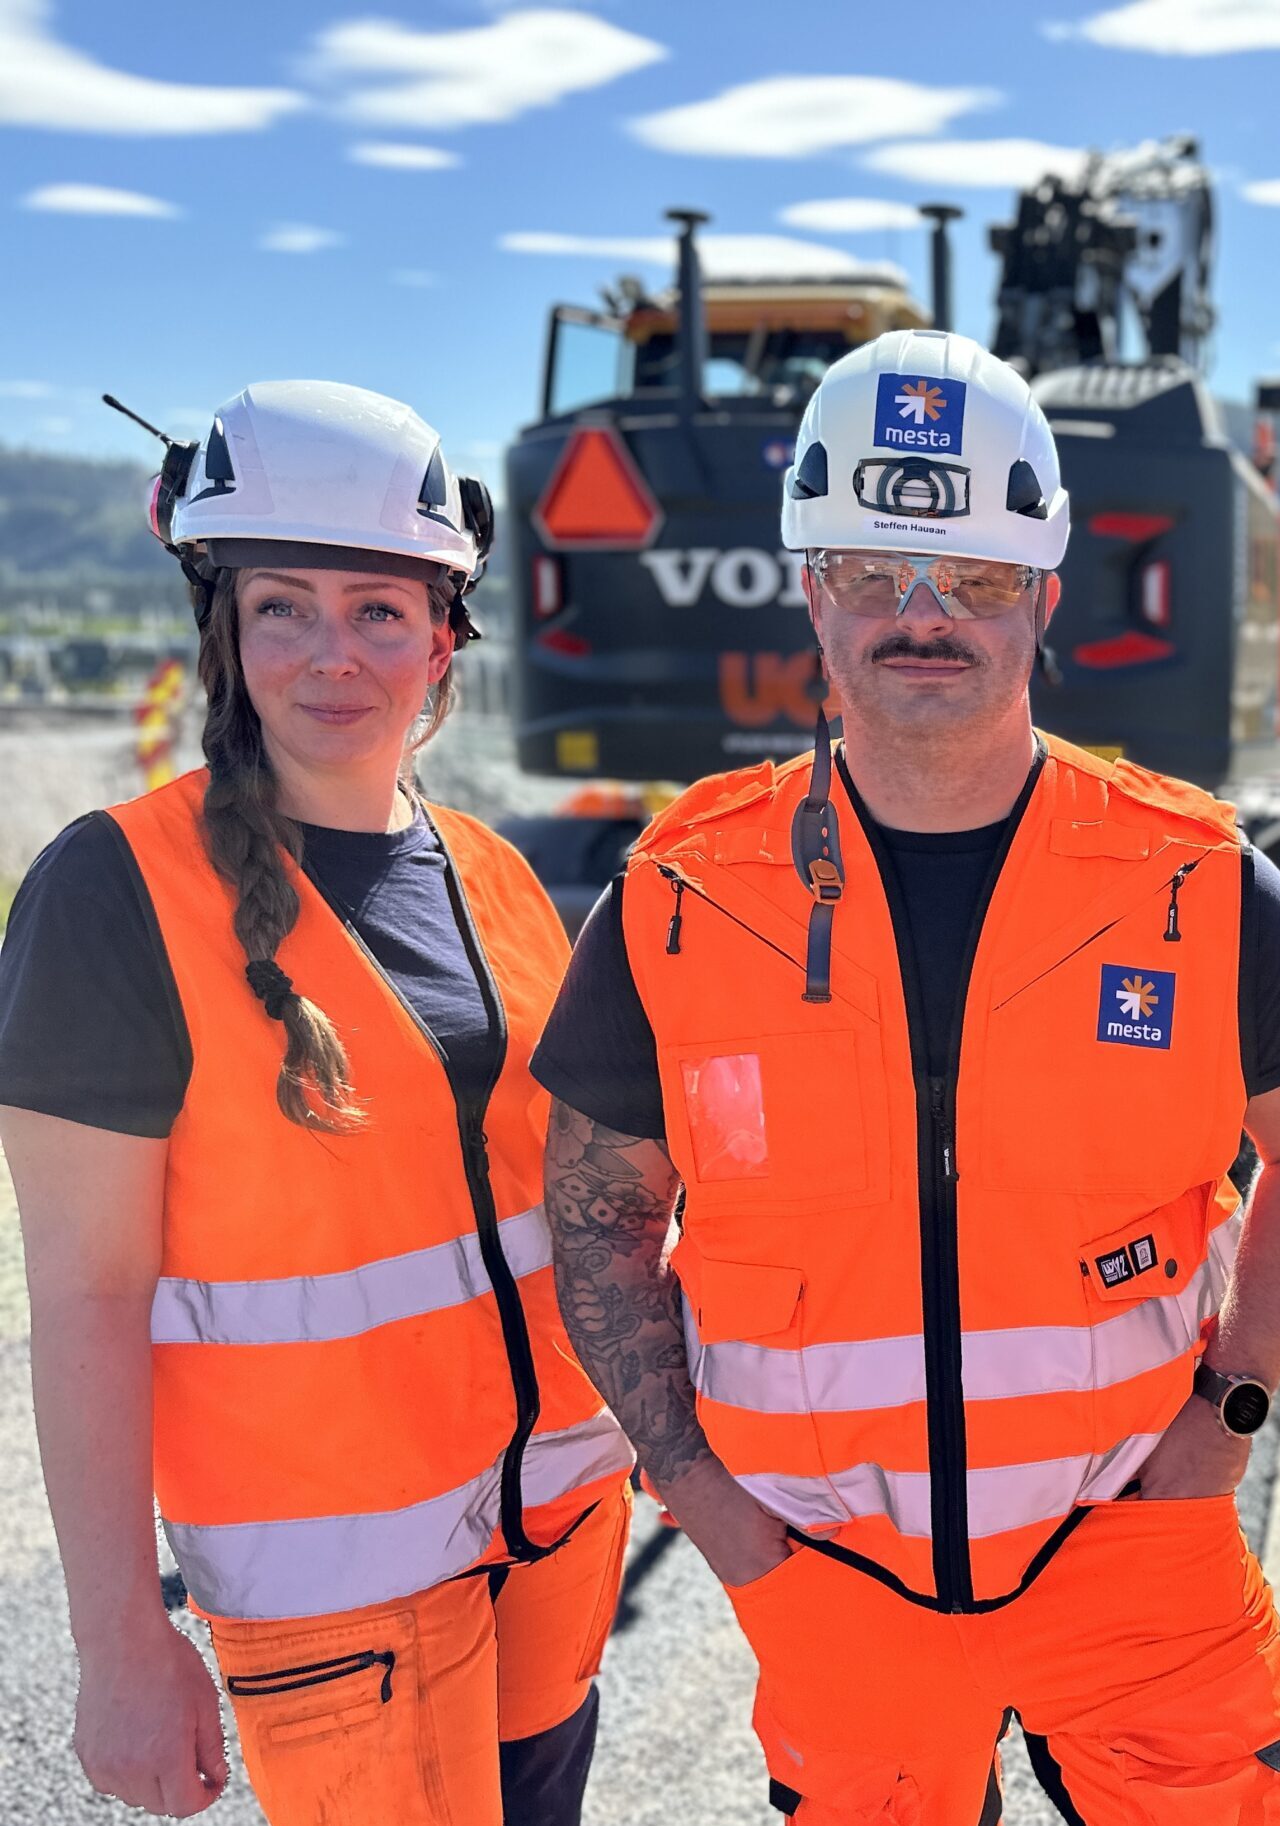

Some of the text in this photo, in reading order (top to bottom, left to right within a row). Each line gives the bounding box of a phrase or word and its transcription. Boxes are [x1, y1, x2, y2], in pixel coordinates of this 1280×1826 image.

[885, 427, 951, 447] mesta
[873, 520, 908, 531] Steffen
[1107, 1021, 1162, 1042] mesta
